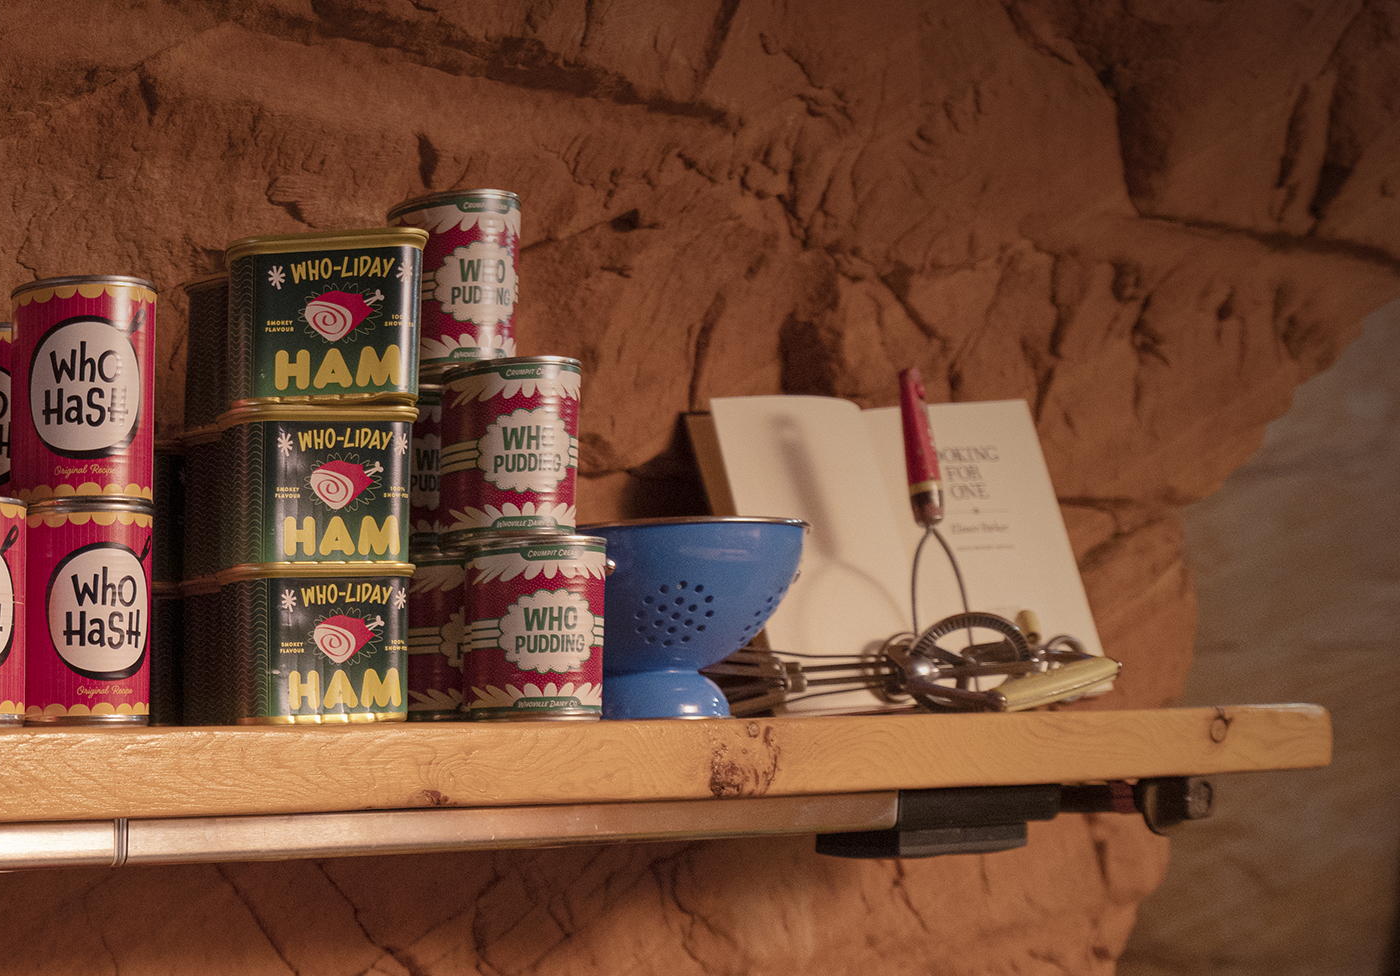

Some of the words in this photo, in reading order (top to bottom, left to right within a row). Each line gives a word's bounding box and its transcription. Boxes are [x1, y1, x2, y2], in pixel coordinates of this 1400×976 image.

[290, 255, 396, 284] WHO-LIDAY
[459, 259, 505, 283] WO
[451, 286, 510, 307] PUDNG
[275, 344, 400, 391] HAM
[505, 368, 535, 377] CRUMPIT
[297, 428, 393, 452] WHO-LIDAY
[502, 425, 555, 450] WHO
[494, 453, 561, 474] PUDDING
[938, 445, 999, 462] OKING
[54, 464, 88, 479] Original
[945, 465, 983, 482] FOR
[951, 483, 990, 500] ONE
[496, 520, 527, 528] WHOVILLE
[284, 515, 401, 556] HAM
[528, 550, 557, 558] CRUMPIT
[301, 582, 393, 607] WHO-LIDAY
[523, 606, 578, 631] WHO
[515, 634, 585, 654] PUDDING
[77, 685, 109, 699] Original
[111, 686, 133, 696] Recipe
[288, 667, 402, 710] HAM
